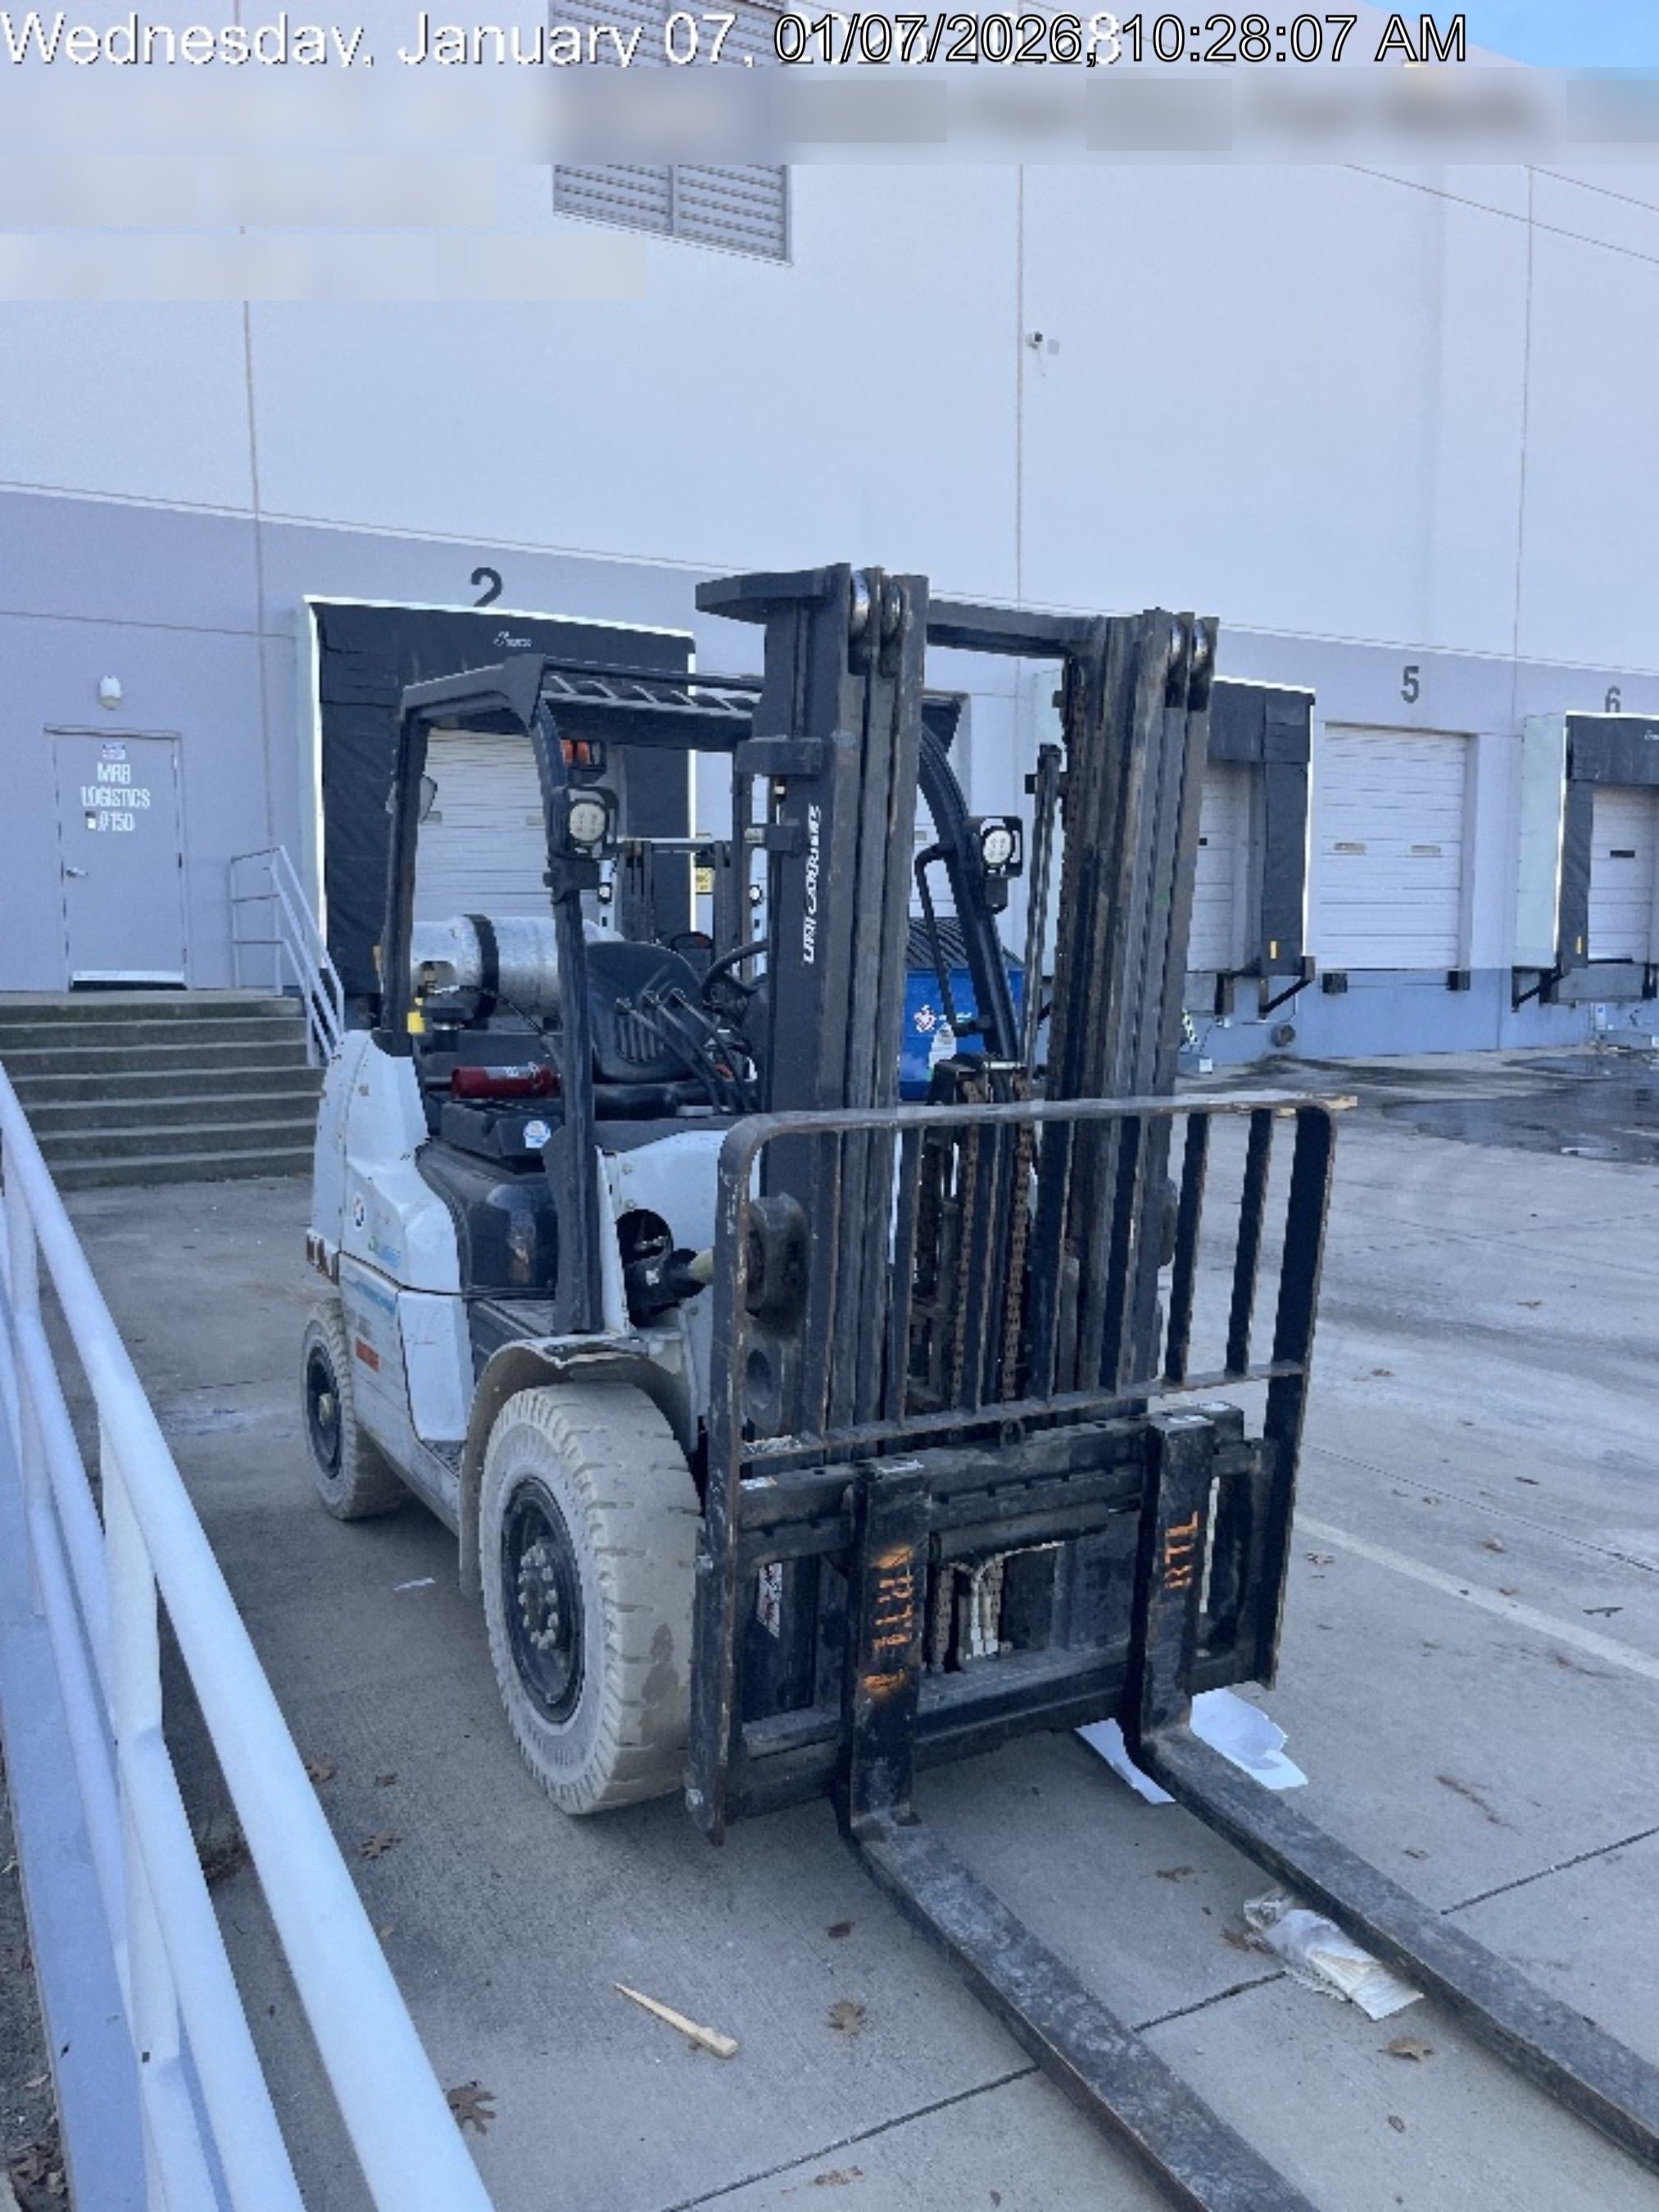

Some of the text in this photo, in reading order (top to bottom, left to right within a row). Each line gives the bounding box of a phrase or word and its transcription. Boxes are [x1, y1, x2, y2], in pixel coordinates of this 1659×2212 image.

[470, 567, 503, 607] 2
[1400, 665, 1420, 704] 5
[1605, 686, 1621, 713] 6
[80, 785, 151, 809] LOGISTICS
